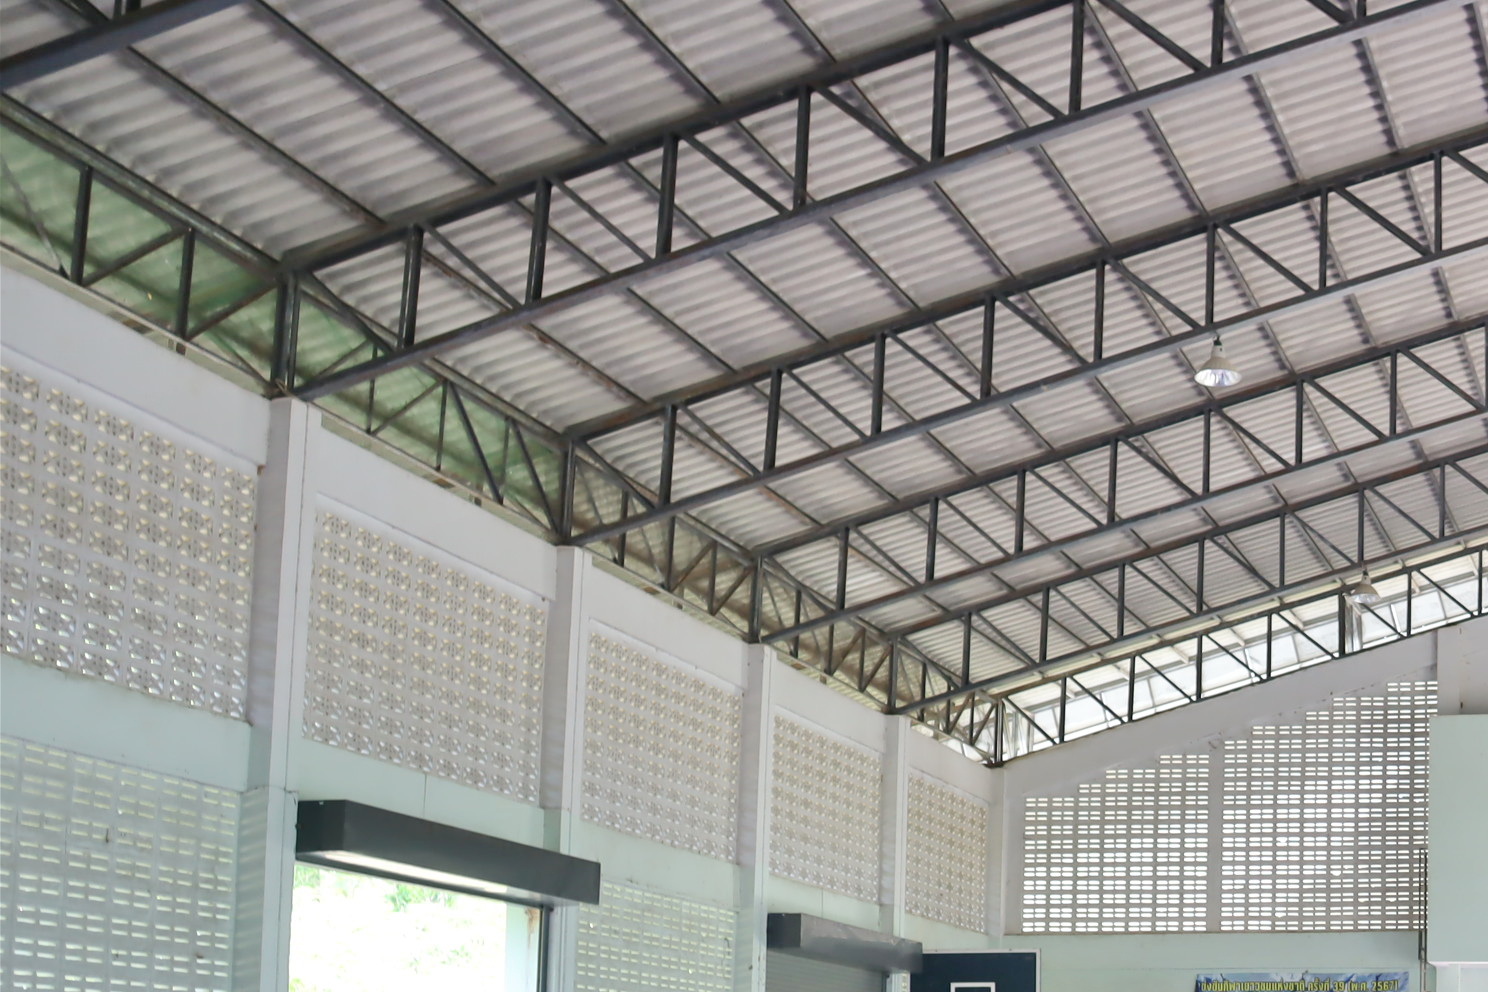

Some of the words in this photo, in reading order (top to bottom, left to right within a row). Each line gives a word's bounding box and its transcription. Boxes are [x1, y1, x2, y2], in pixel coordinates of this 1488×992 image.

[1307, 977, 1331, 992] ครั้งที่
[1333, 980, 1345, 992] 39
[1371, 980, 1399, 992] 2567)
